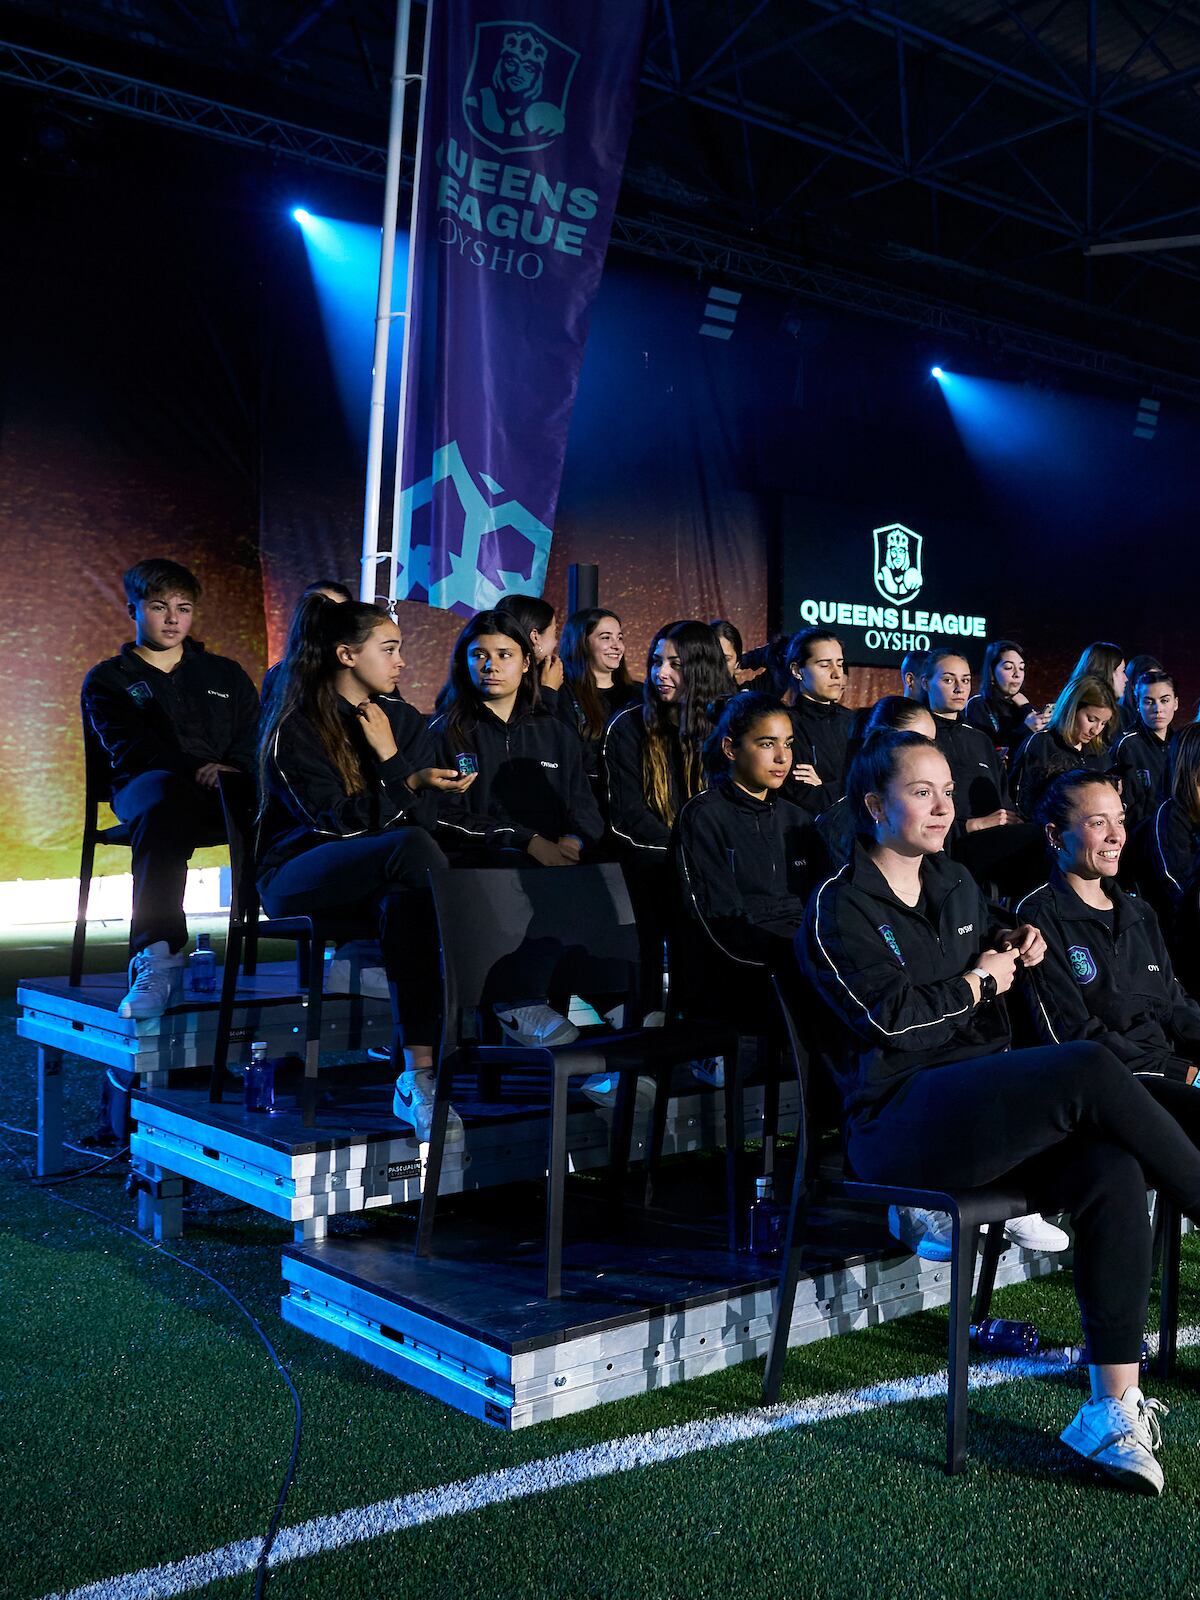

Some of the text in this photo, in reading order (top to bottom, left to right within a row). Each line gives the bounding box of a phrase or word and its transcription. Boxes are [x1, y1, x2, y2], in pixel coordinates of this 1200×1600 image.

[438, 217, 543, 279] OYSHO
[800, 600, 985, 637] QUEENS LEAGUE
[865, 630, 930, 652] OYSHO
